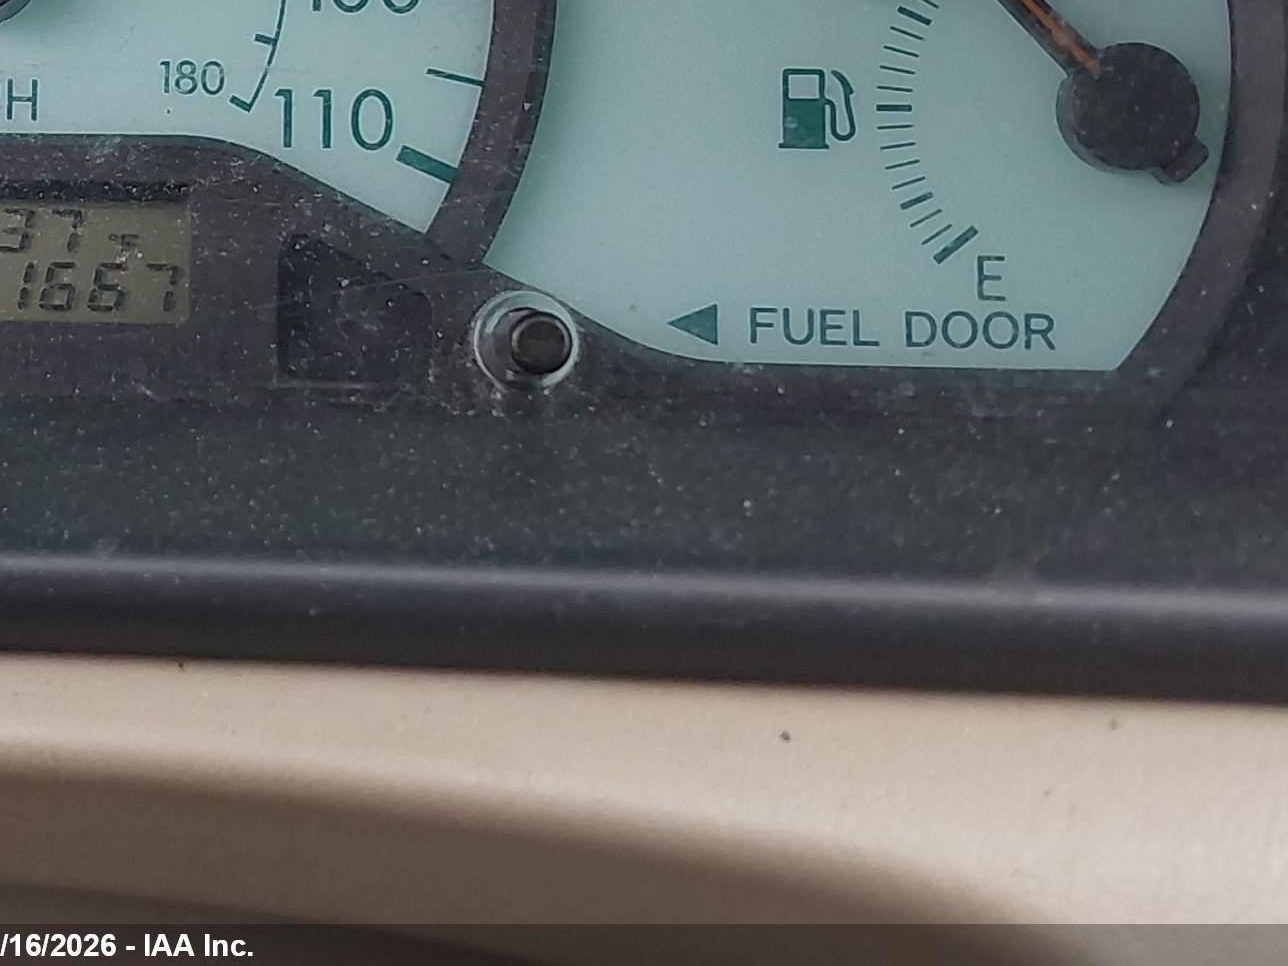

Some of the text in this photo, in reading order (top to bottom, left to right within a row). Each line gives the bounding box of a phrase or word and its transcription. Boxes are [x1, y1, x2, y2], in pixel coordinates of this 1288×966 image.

[160, 60, 224, 95] 180
[275, 89, 393, 150] 110
[978, 256, 1006, 301] E
[750, 308, 1055, 350] FUEL DOOR
